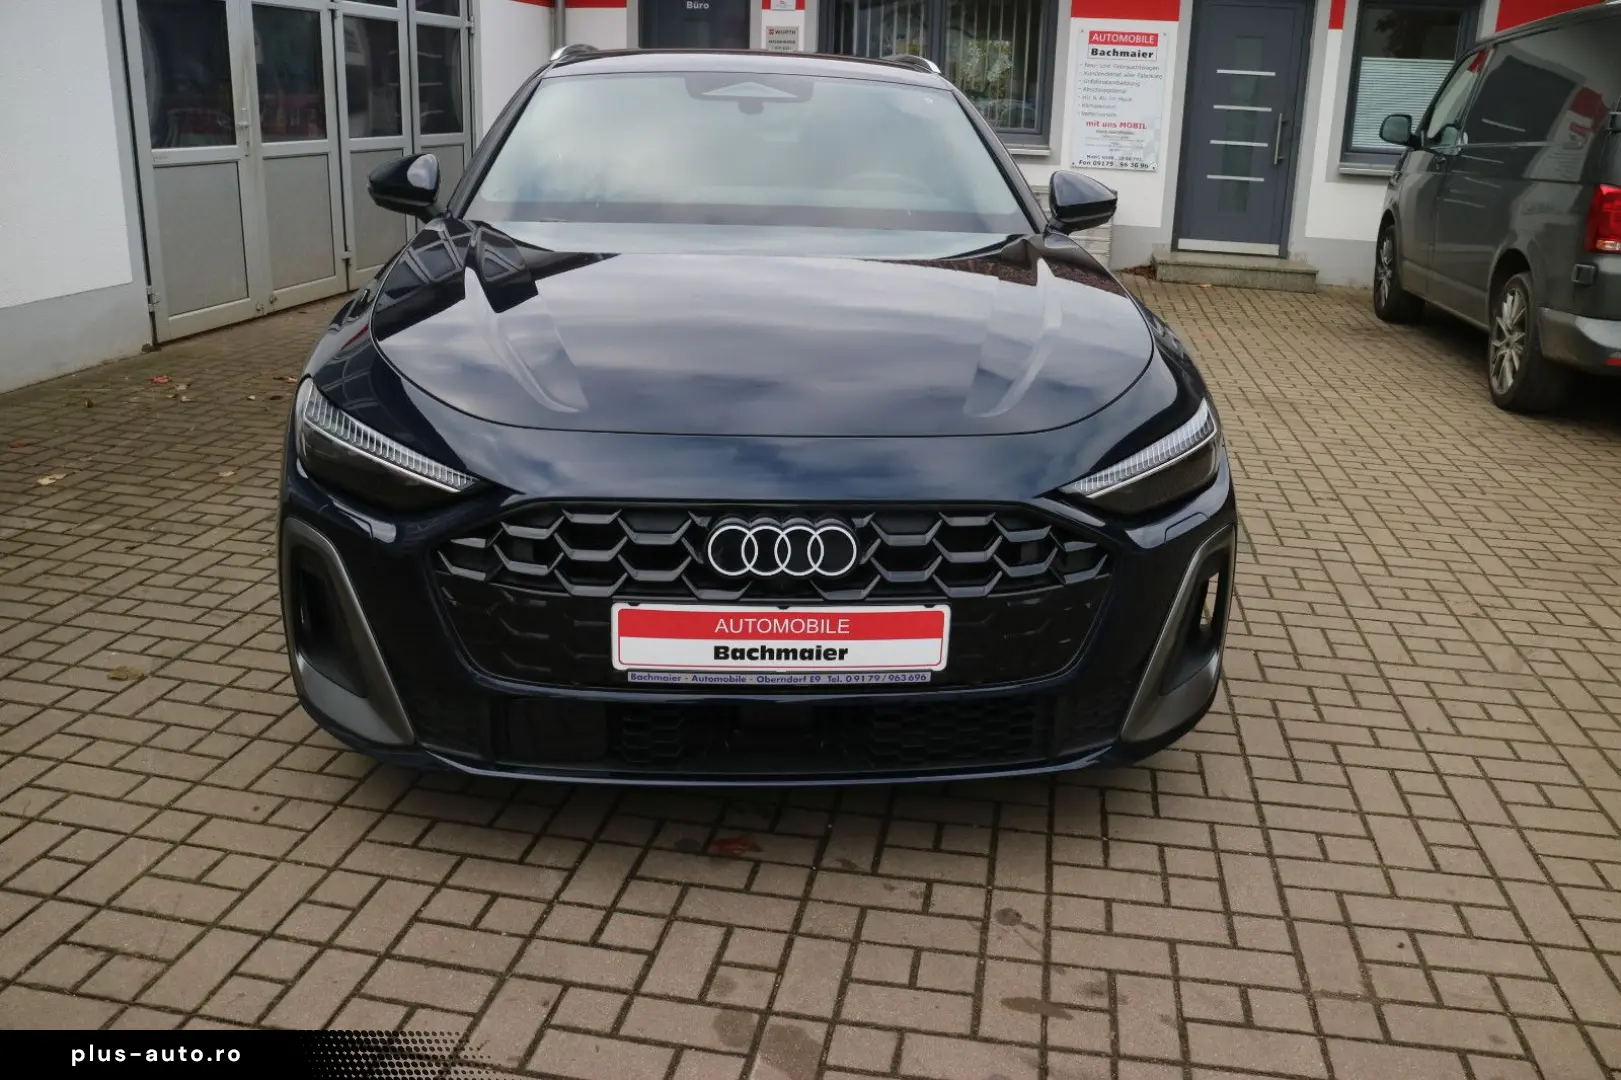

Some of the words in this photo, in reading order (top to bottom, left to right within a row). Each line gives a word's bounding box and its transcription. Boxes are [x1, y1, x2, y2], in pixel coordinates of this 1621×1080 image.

[686, 1, 710, 9] Büro
[1091, 32, 1155, 44] AUTOMOBILE
[1090, 48, 1154, 58] Bachmaier
[1119, 122, 1148, 130] MOBIL
[714, 618, 851, 635] AUTOMOBILE
[713, 644, 849, 662] Bachmaier
[630, 673, 682, 682] Bachmaier
[691, 674, 746, 683] Automobile
[756, 676, 807, 684] Oberndorf
[827, 675, 843, 683] Tel.
